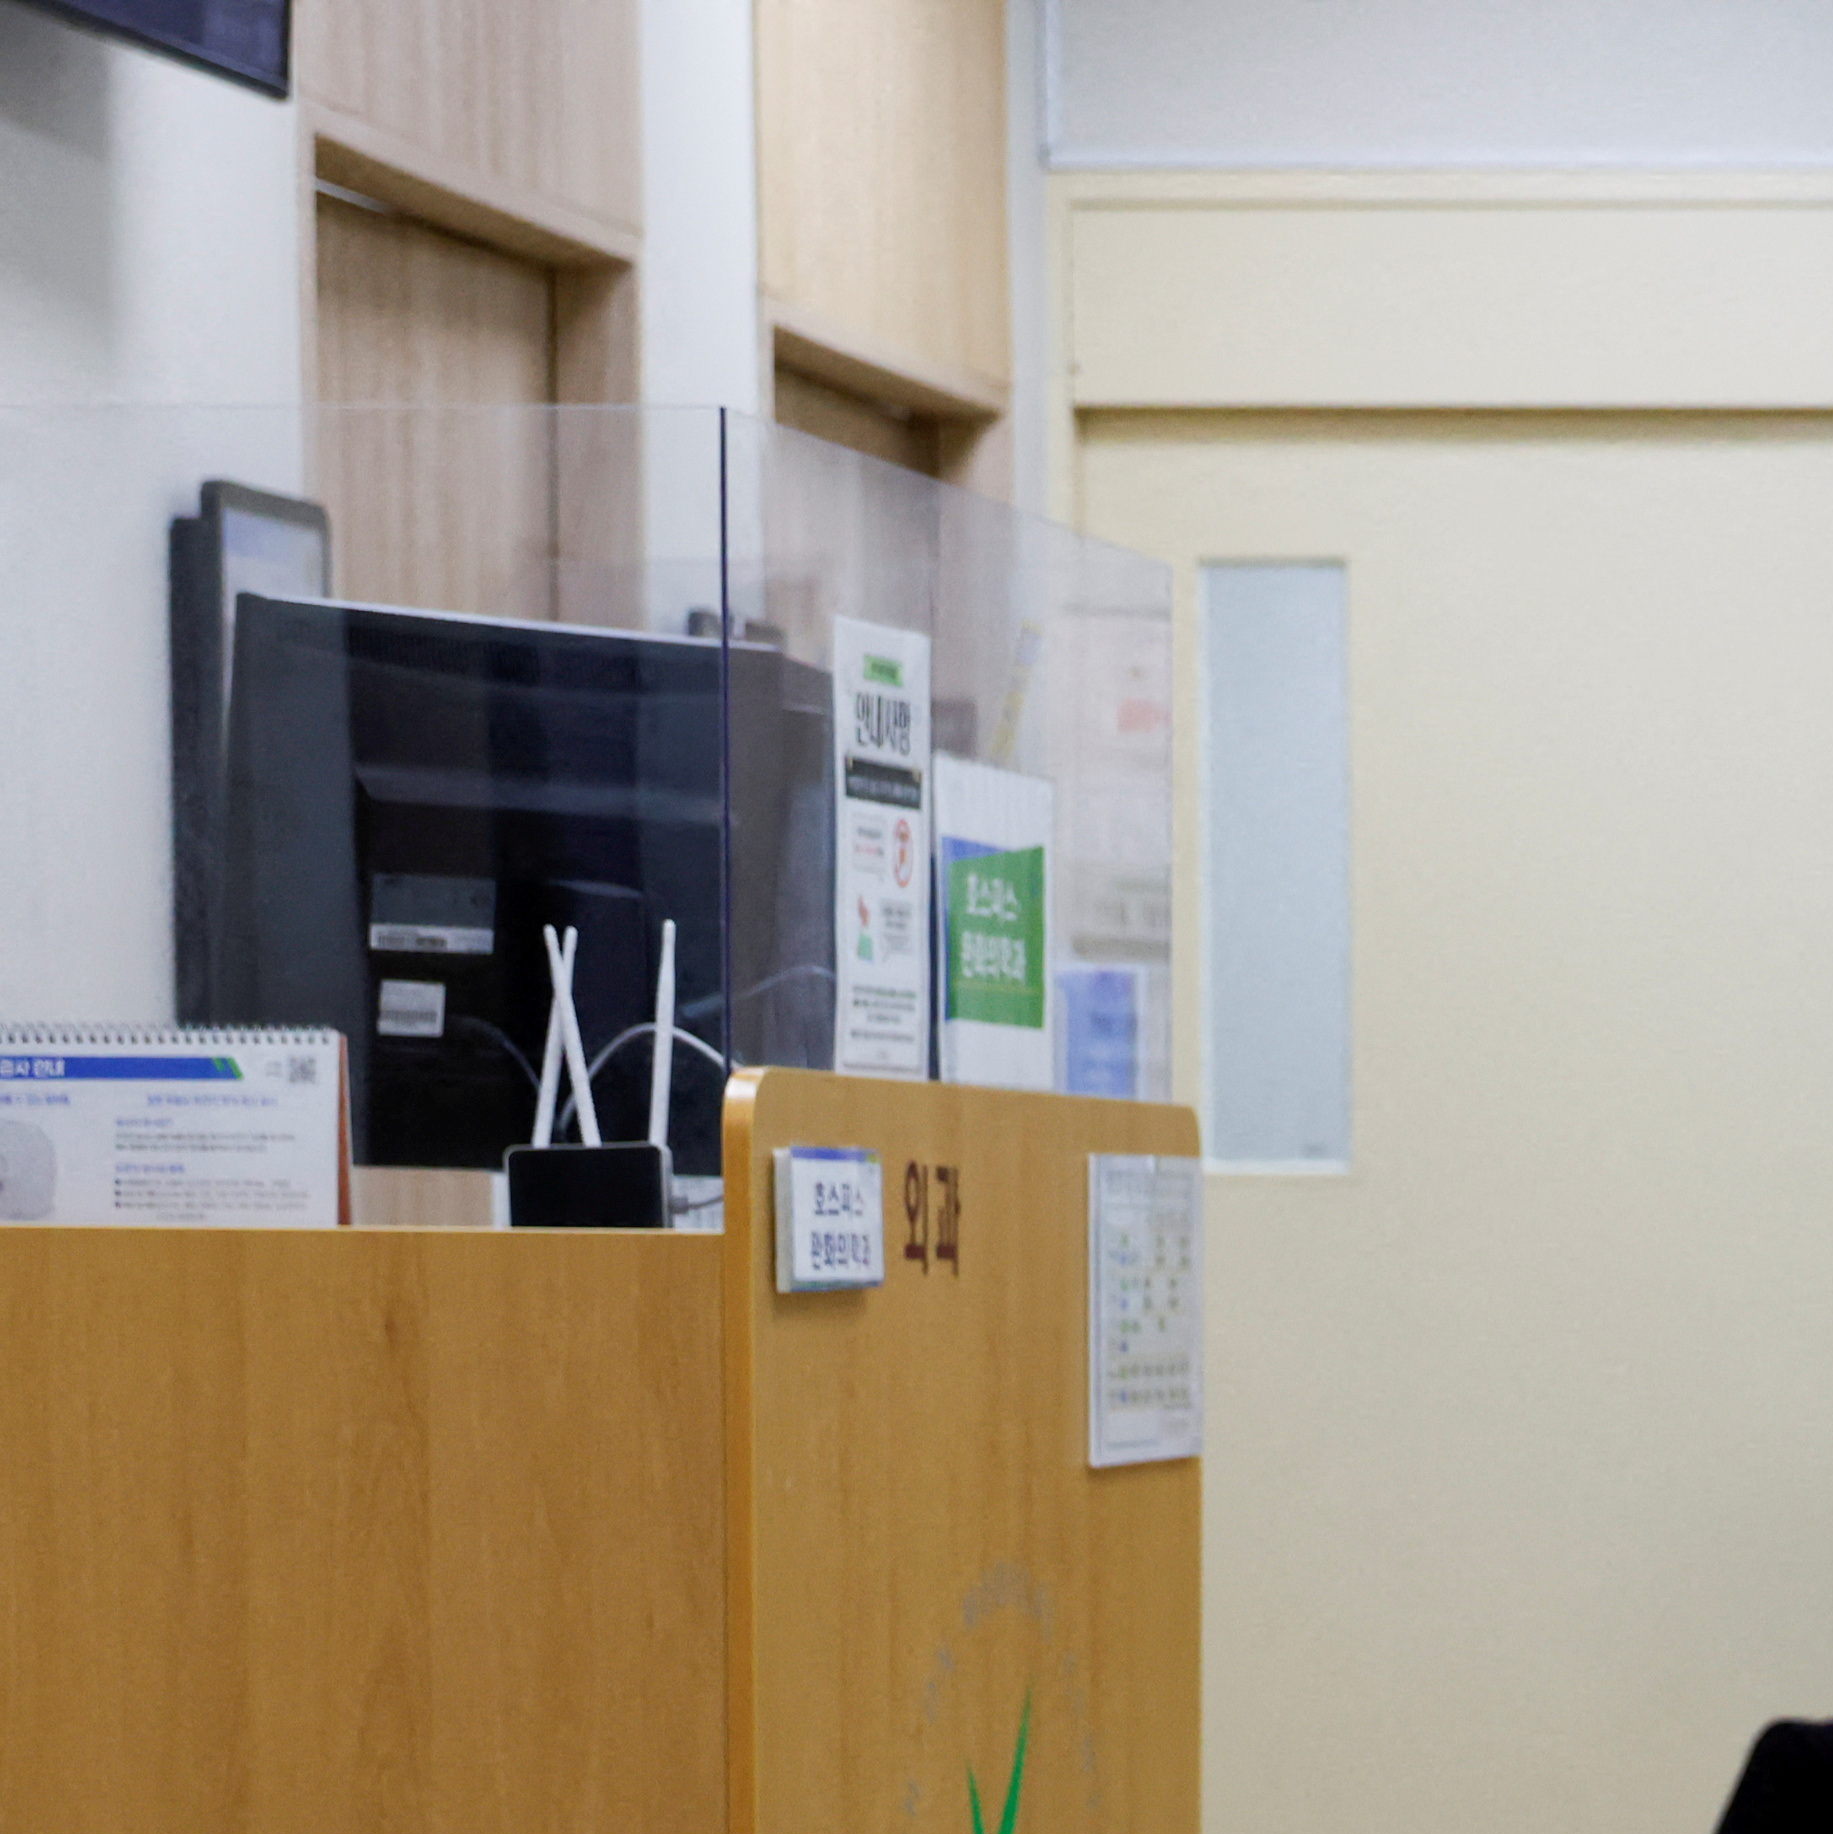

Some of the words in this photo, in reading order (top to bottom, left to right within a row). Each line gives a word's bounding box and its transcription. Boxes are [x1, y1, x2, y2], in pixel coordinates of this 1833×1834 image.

[814, 1181, 865, 1217] 호스피스
[903, 1160, 961, 1277] 외과
[810, 1231, 871, 1271] 완화의학과
